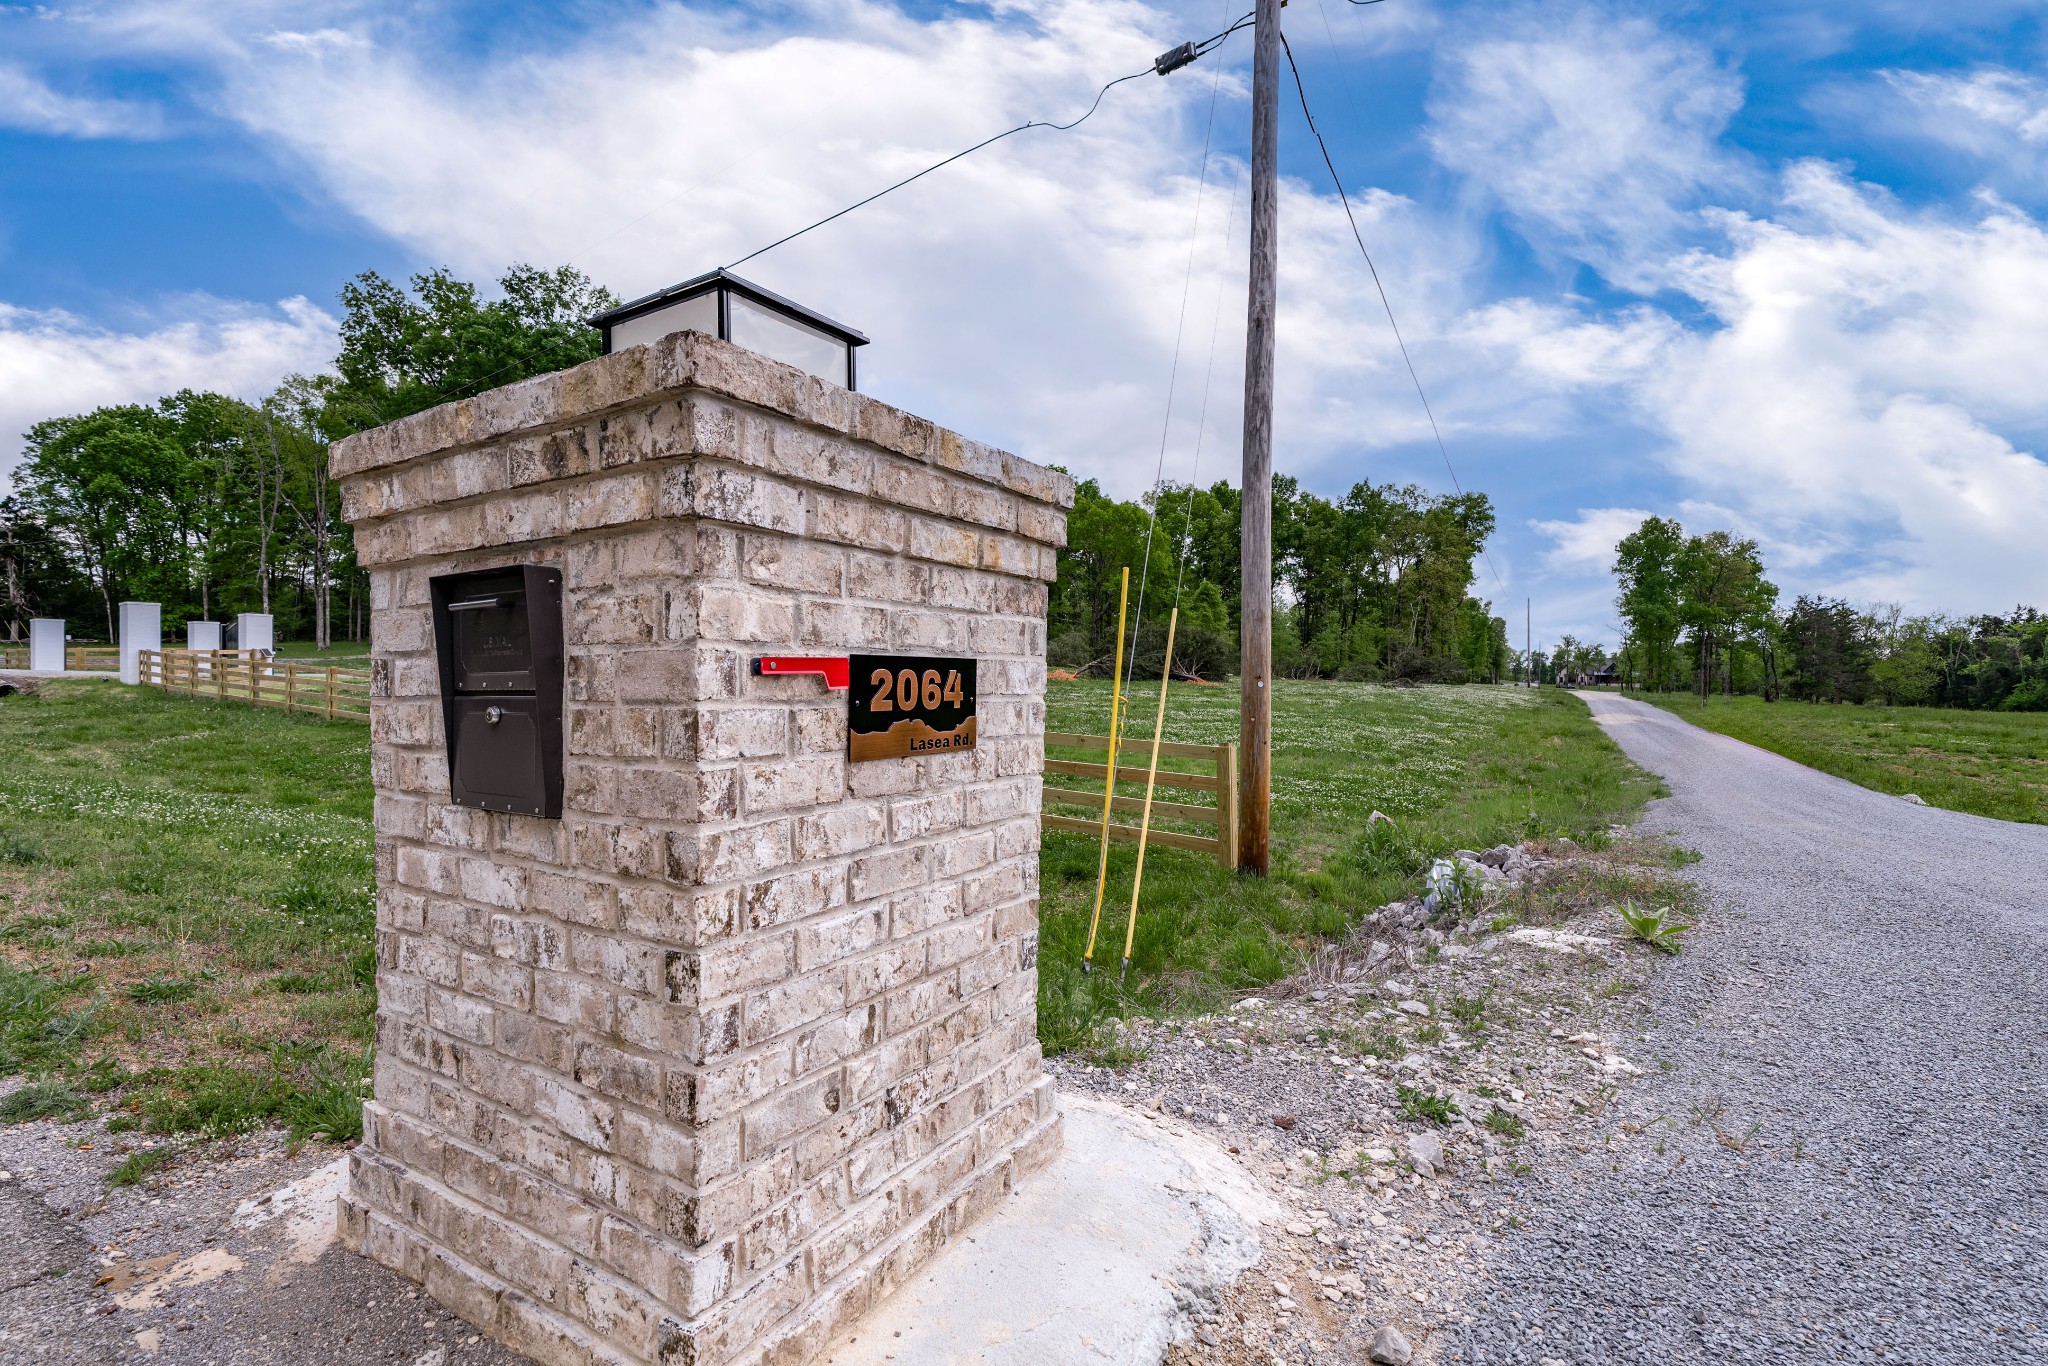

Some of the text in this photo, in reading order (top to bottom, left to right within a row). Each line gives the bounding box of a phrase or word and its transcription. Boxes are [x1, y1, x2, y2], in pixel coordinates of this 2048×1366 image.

[870, 668, 964, 712] 2064
[910, 733, 973, 751] Lasea Rd.
